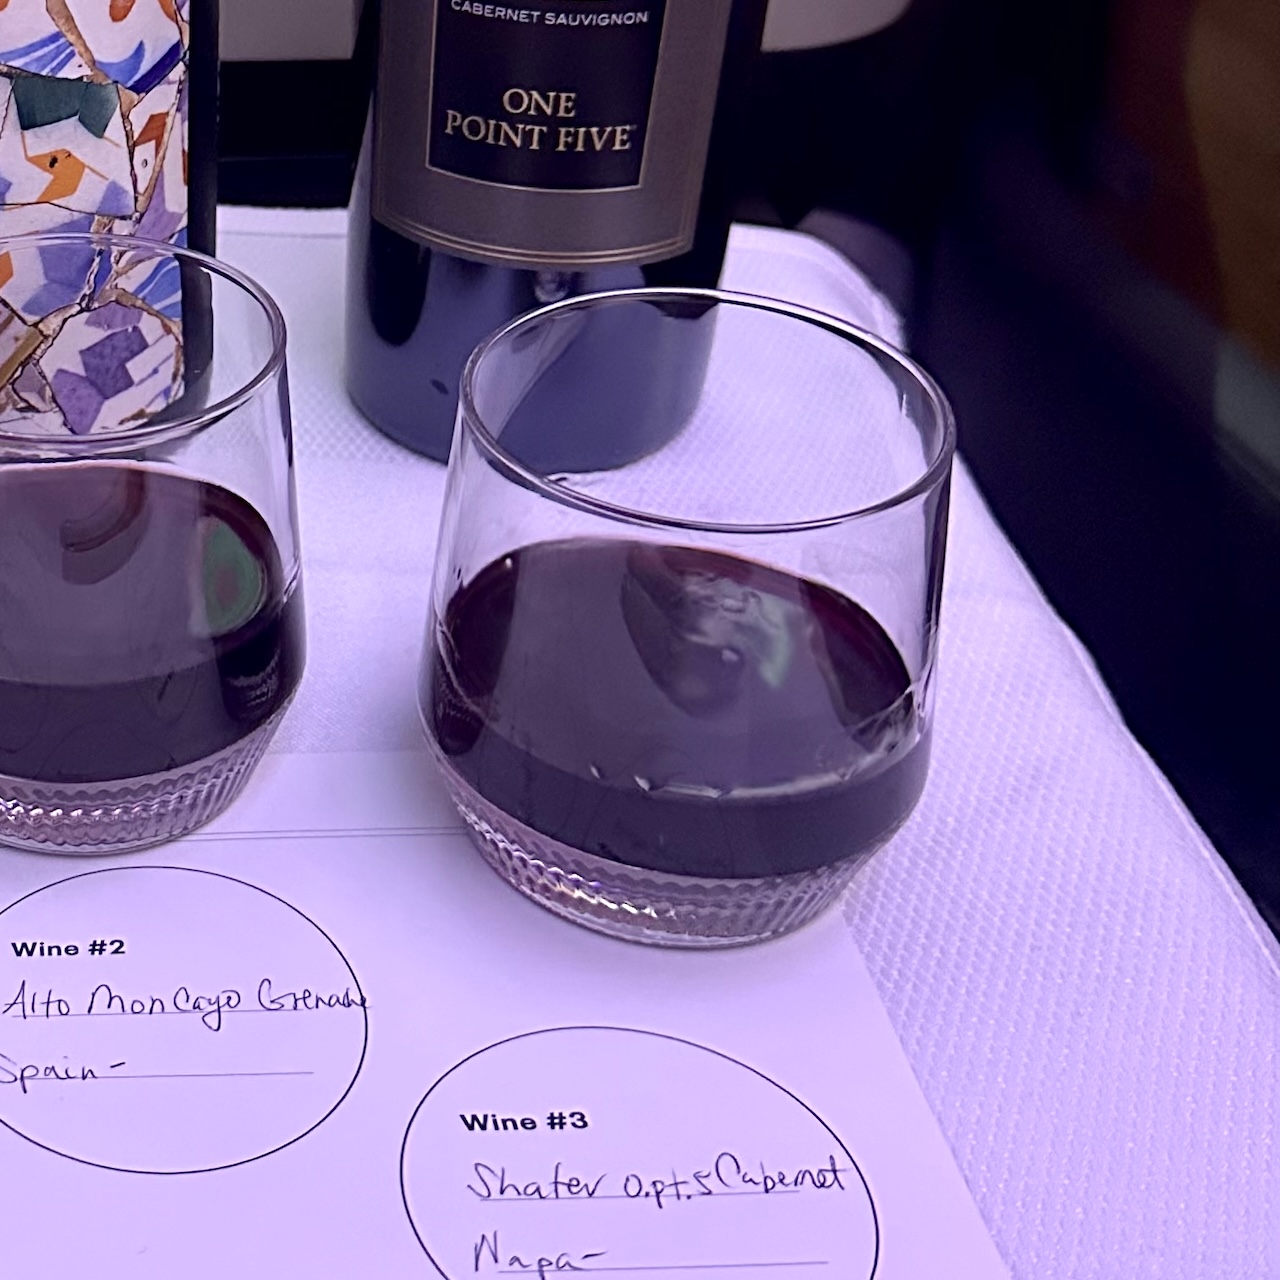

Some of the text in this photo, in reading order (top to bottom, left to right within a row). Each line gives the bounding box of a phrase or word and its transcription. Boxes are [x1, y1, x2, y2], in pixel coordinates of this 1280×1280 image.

[544, 11, 649, 26] SAUVIGNON
[502, 88, 577, 117] ONE
[445, 110, 633, 152] POINT FIVE
[11, 939, 126, 957] Wine #2
[2, 979, 70, 1020] Alto
[460, 1111, 589, 1132] Wine #3
[715, 1151, 848, 1194] Cabernet
